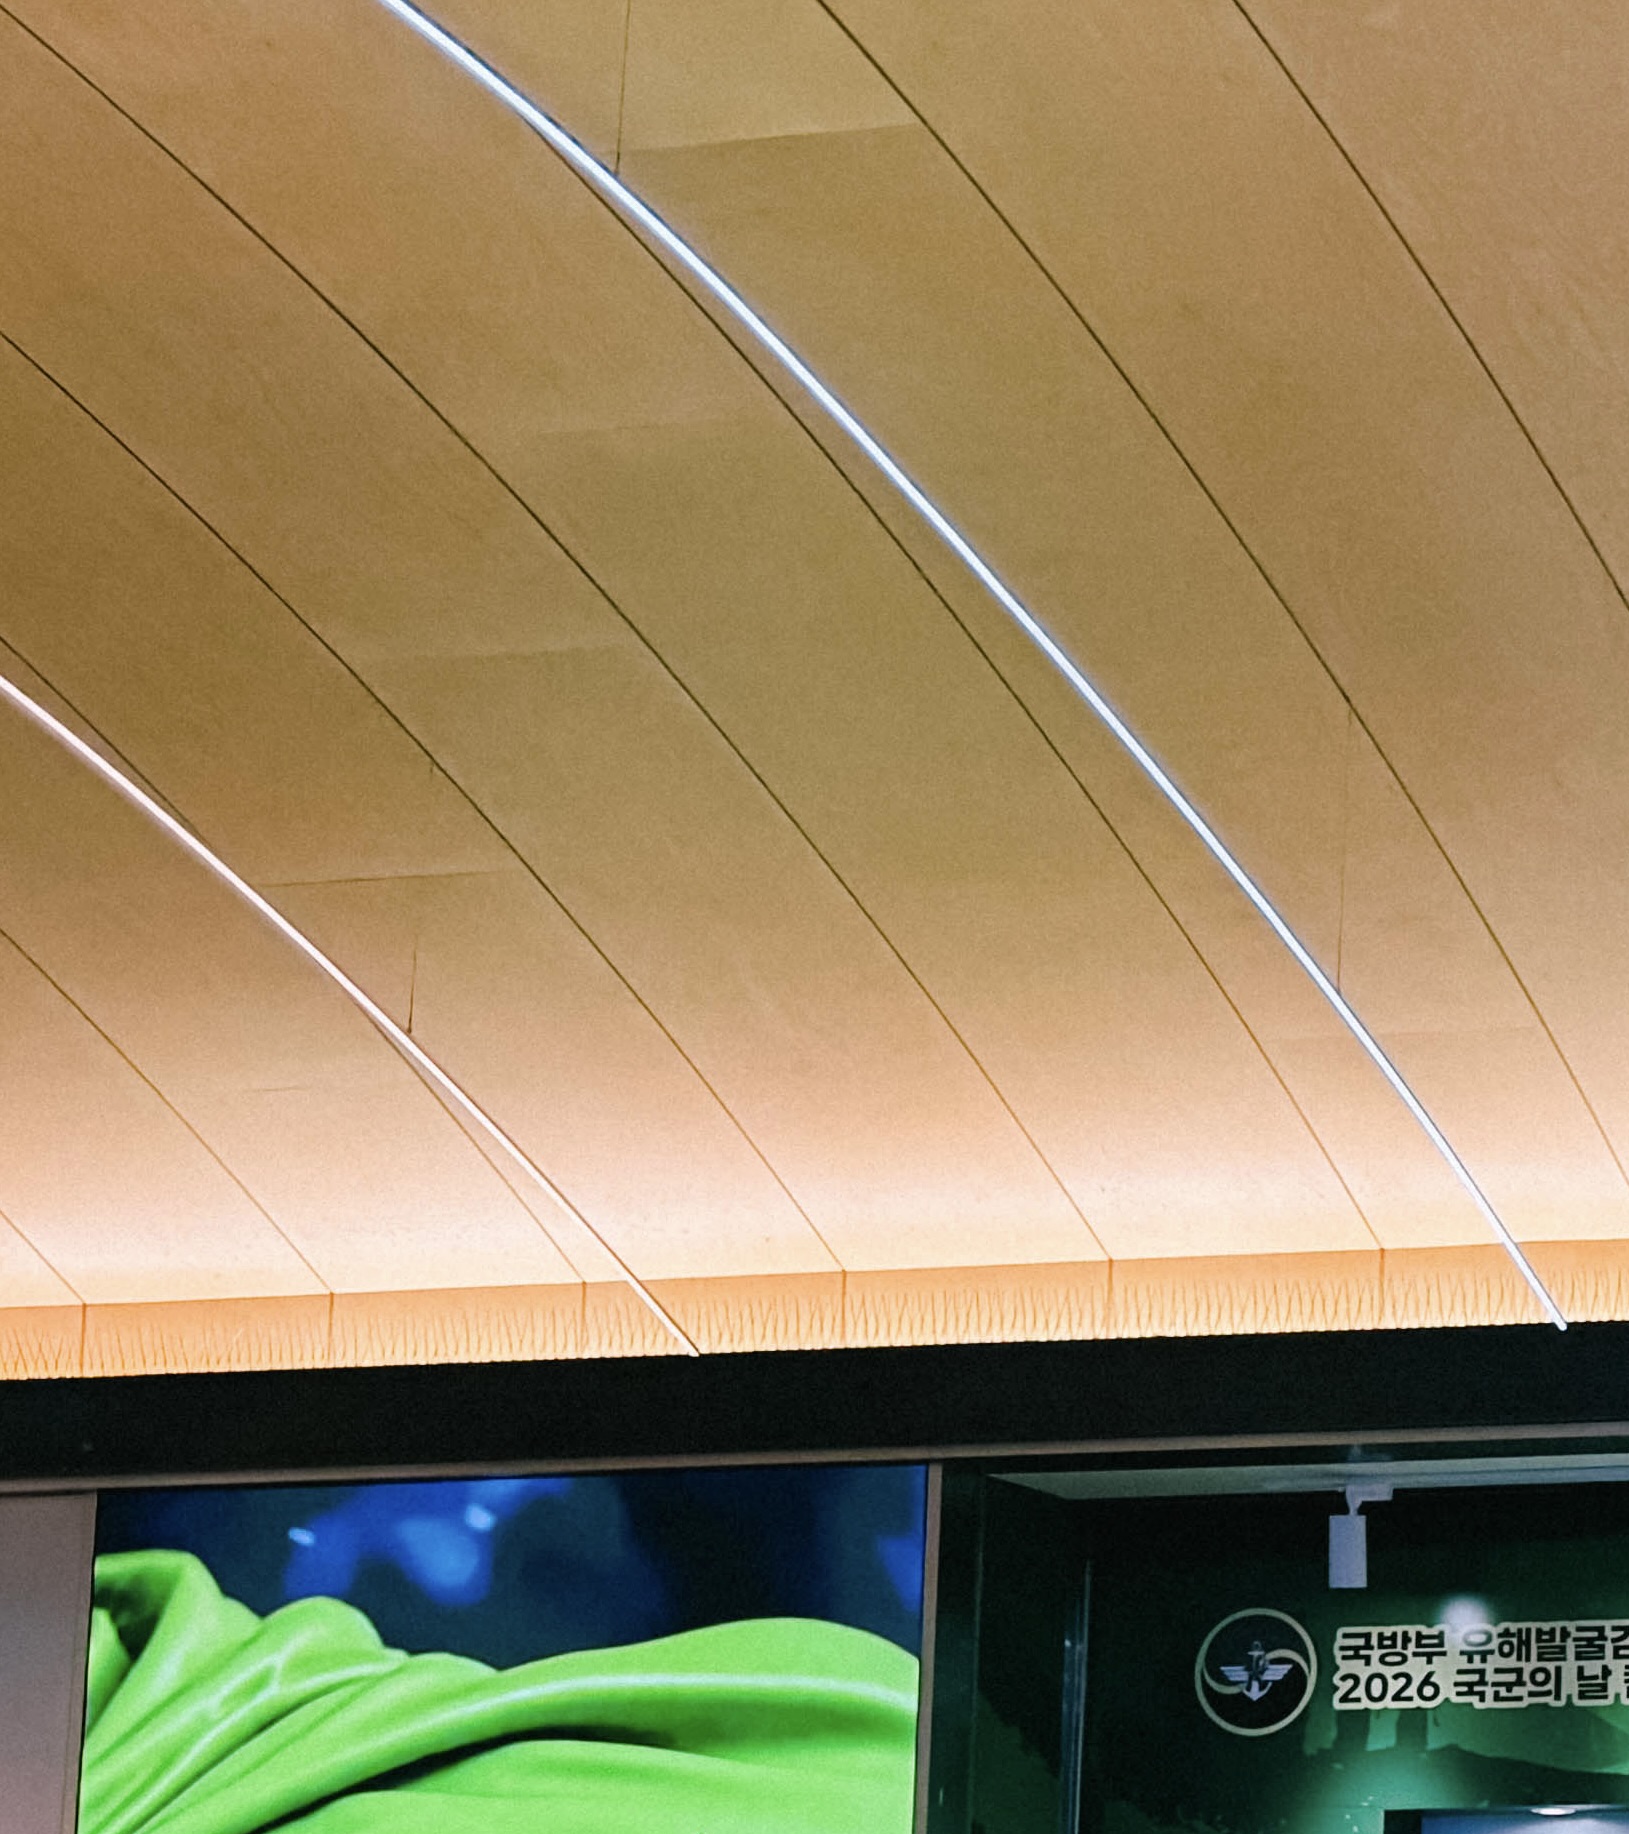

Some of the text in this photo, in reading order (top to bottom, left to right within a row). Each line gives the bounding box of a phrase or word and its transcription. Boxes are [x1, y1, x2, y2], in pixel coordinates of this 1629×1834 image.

[1338, 1631, 1448, 1667] 국방부
[1339, 1670, 1441, 1704] 2026
[1454, 1666, 1564, 1701] 국군의
[1576, 1666, 1611, 1700] 날
